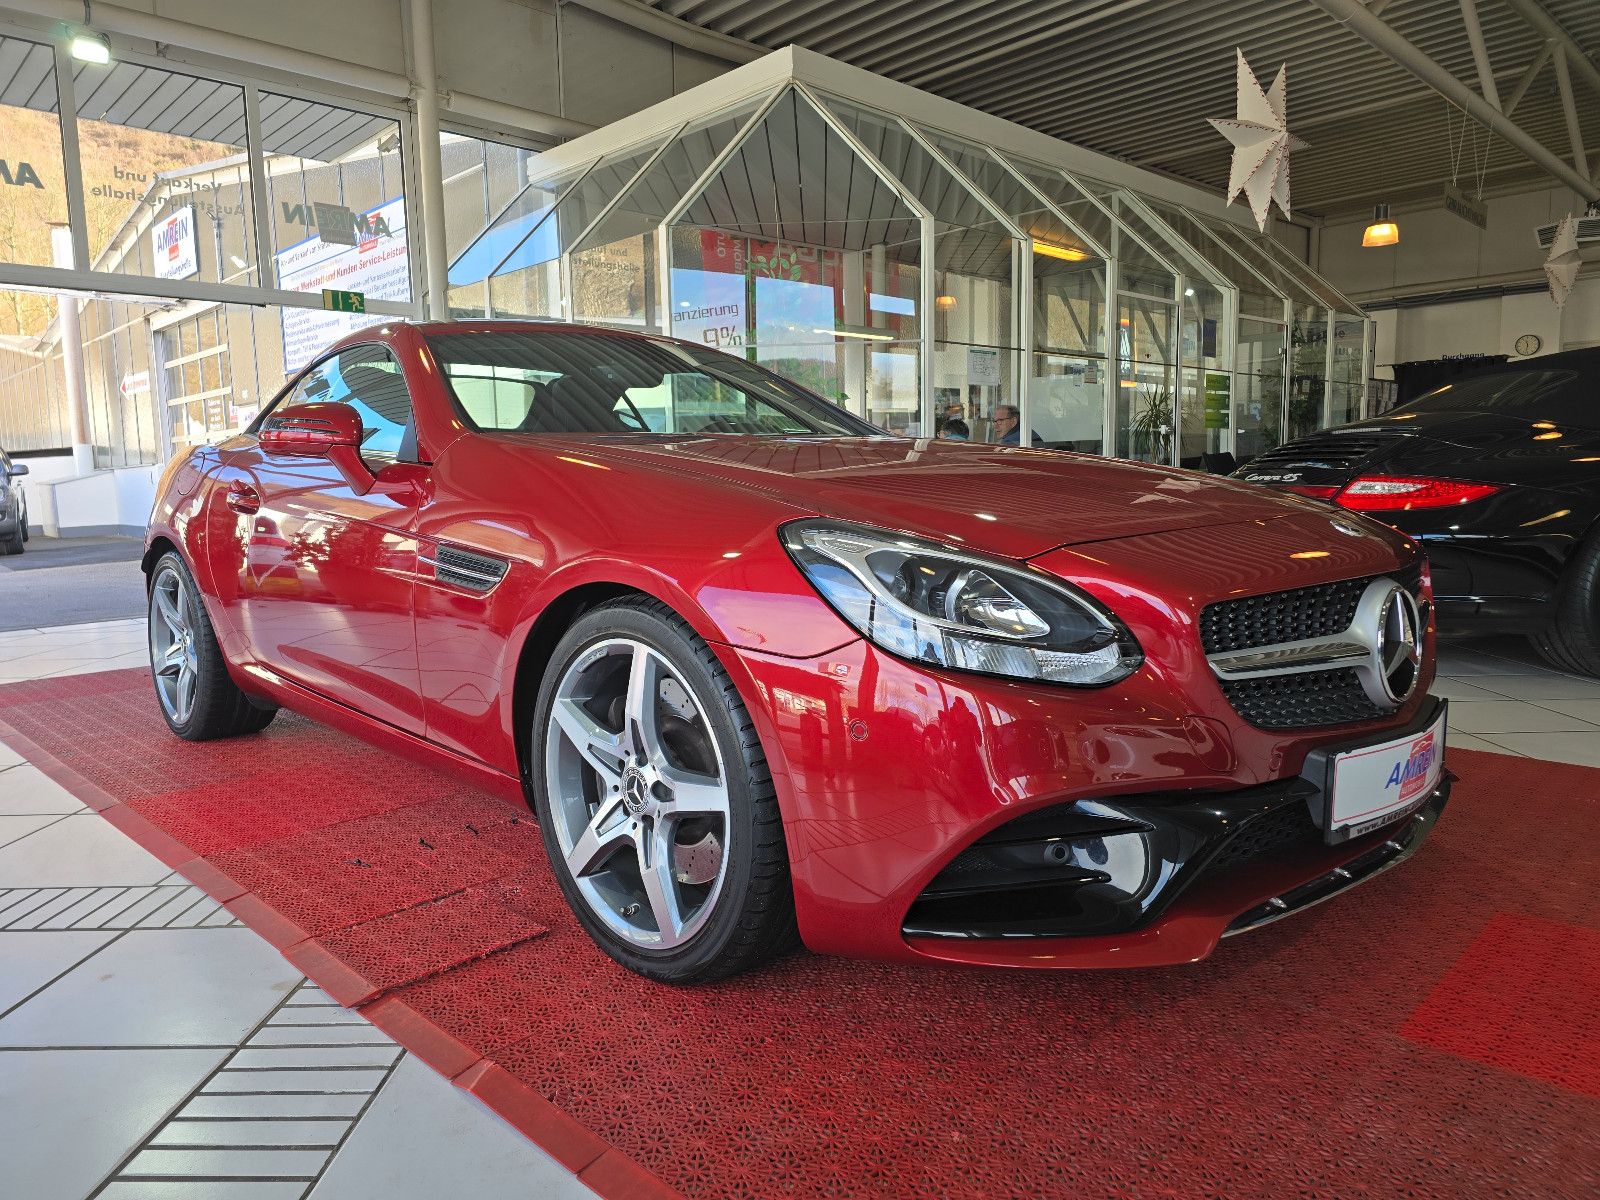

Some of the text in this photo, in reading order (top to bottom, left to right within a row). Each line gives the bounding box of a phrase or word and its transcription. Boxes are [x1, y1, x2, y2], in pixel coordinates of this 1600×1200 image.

[157, 217, 189, 254] AMREIN
[336, 263, 358, 279] Kunden
[673, 303, 739, 322] anzierung
